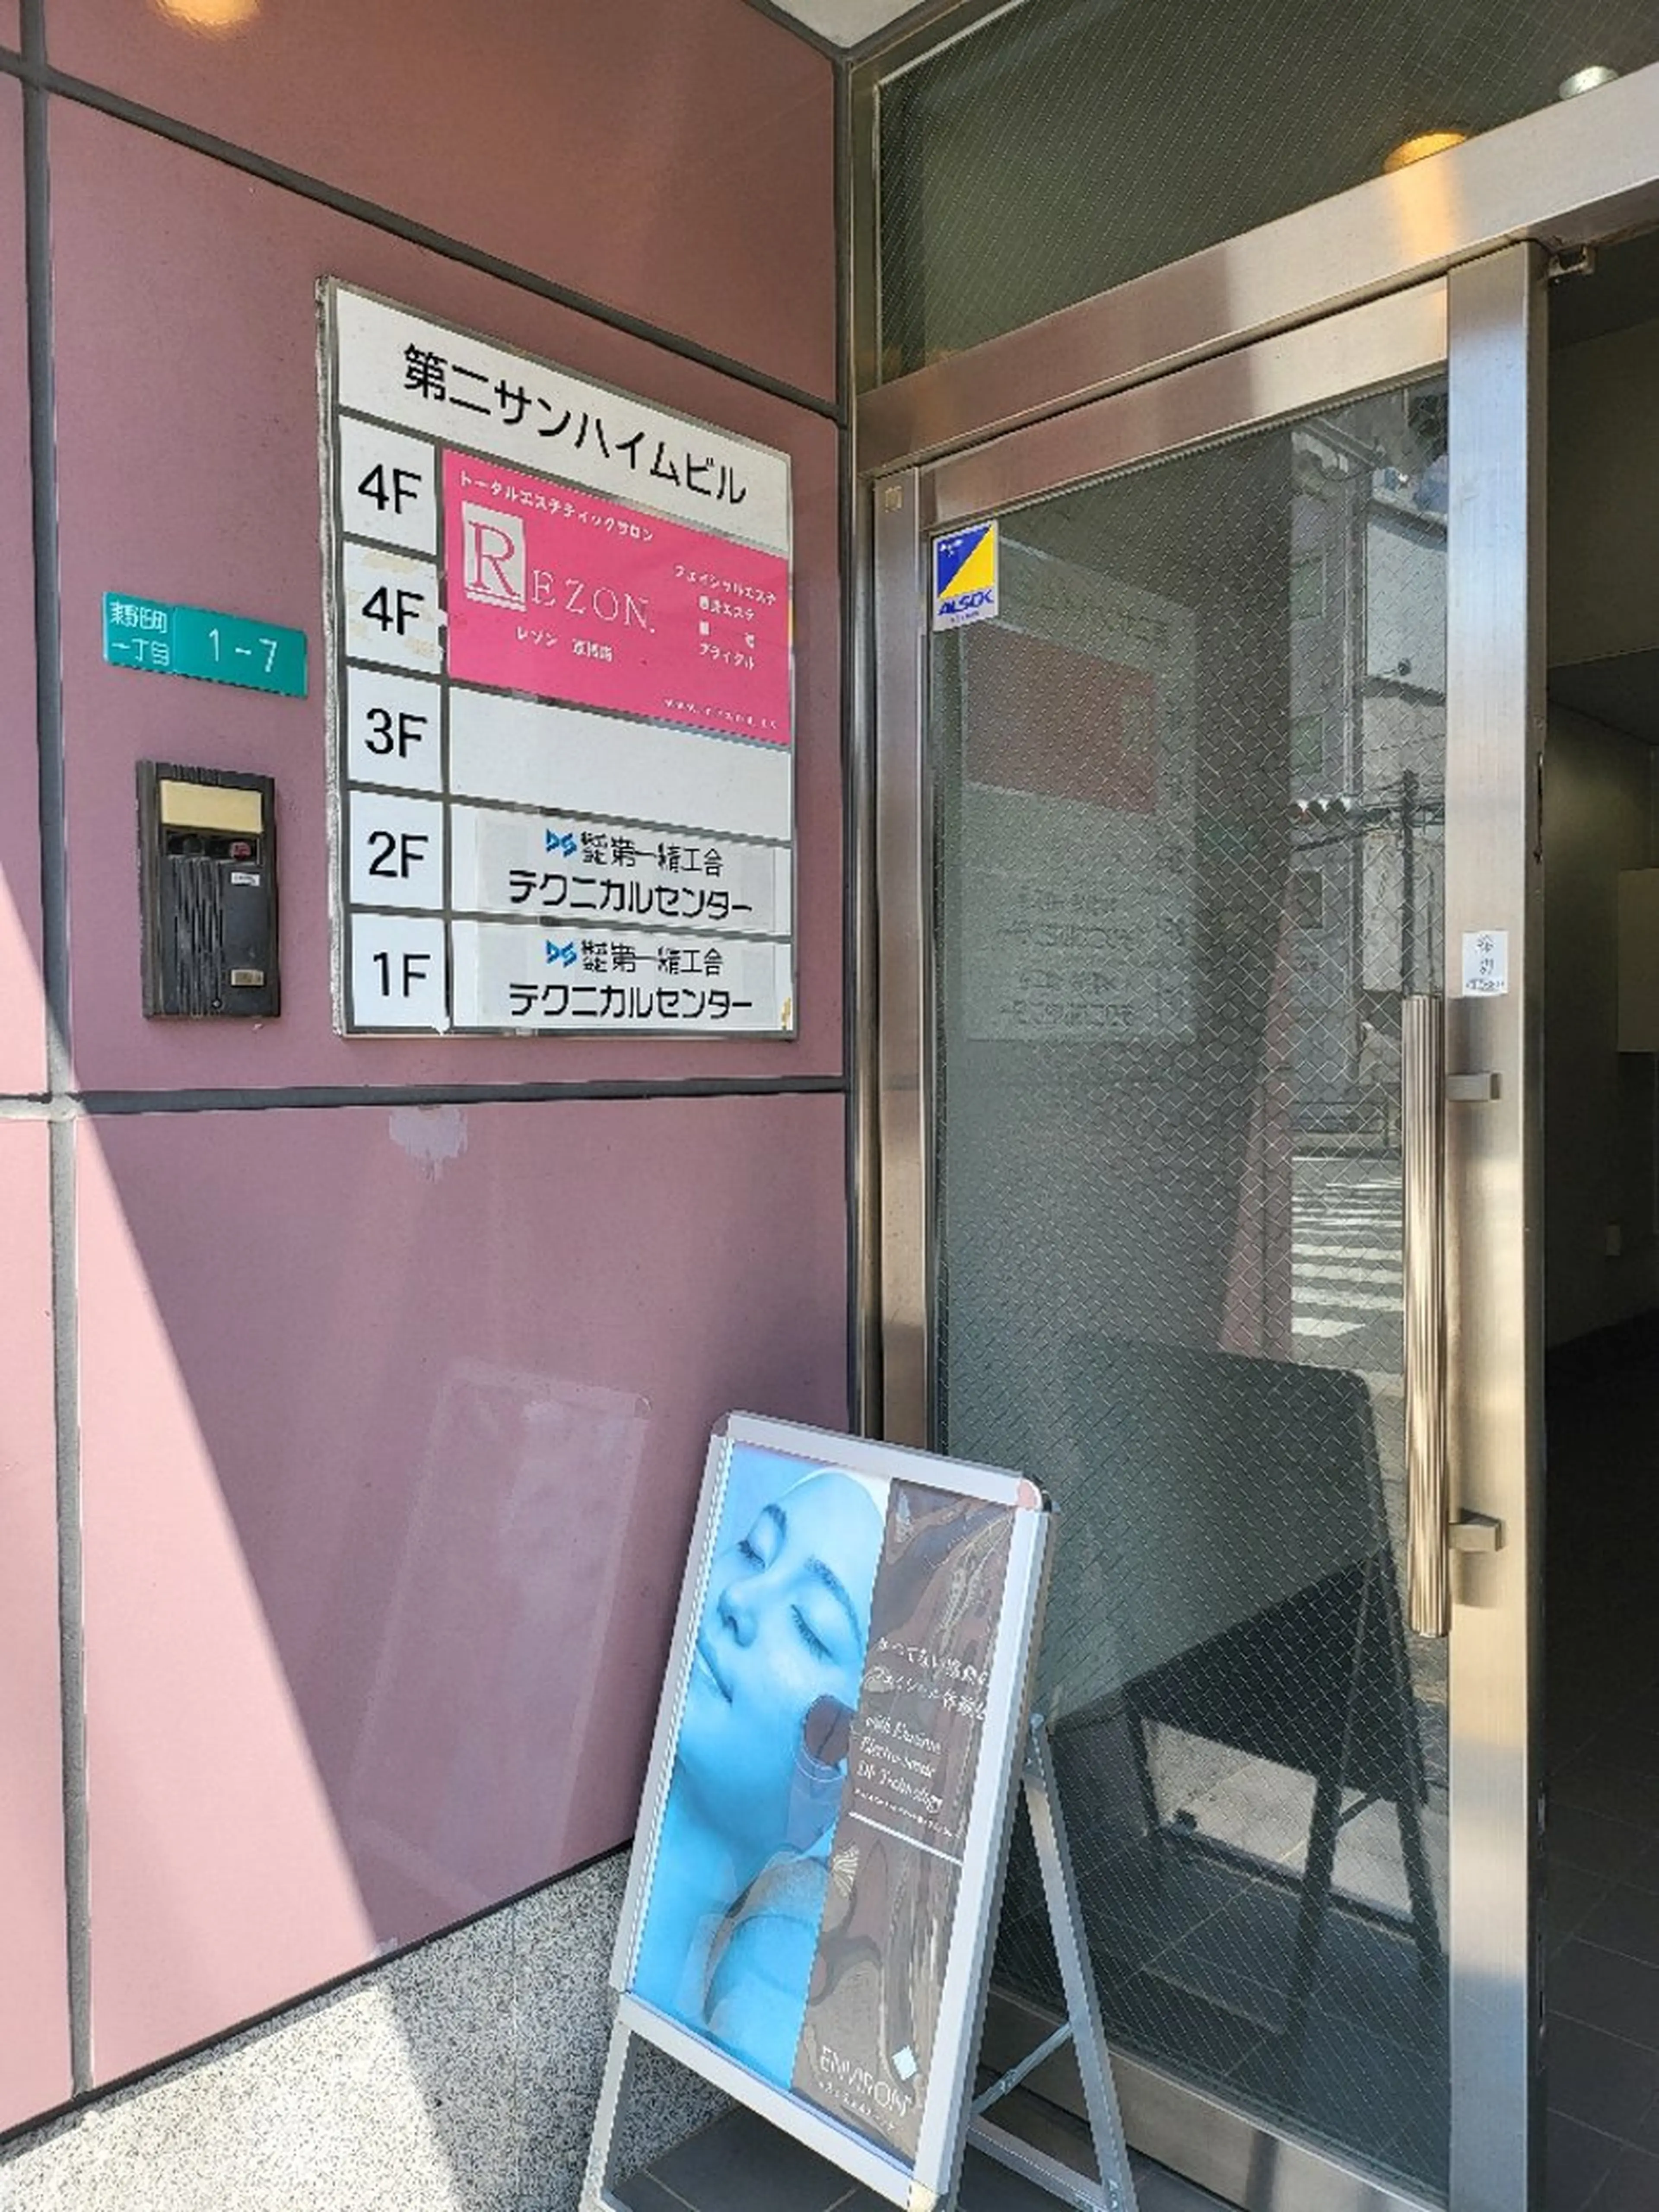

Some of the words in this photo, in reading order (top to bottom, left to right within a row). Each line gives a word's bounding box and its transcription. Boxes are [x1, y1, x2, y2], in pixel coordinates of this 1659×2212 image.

[403, 344, 746, 504] 第二サンハイムビル
[358, 464, 421, 514] 4F
[362, 586, 424, 635] 4F
[111, 638, 170, 667] 一丁目
[365, 708, 428, 758] 3F
[367, 831, 429, 878] 2F
[509, 869, 753, 920] テクニカルセンター
[373, 952, 431, 997] 1F
[509, 983, 753, 1020] テクニカルセンター
